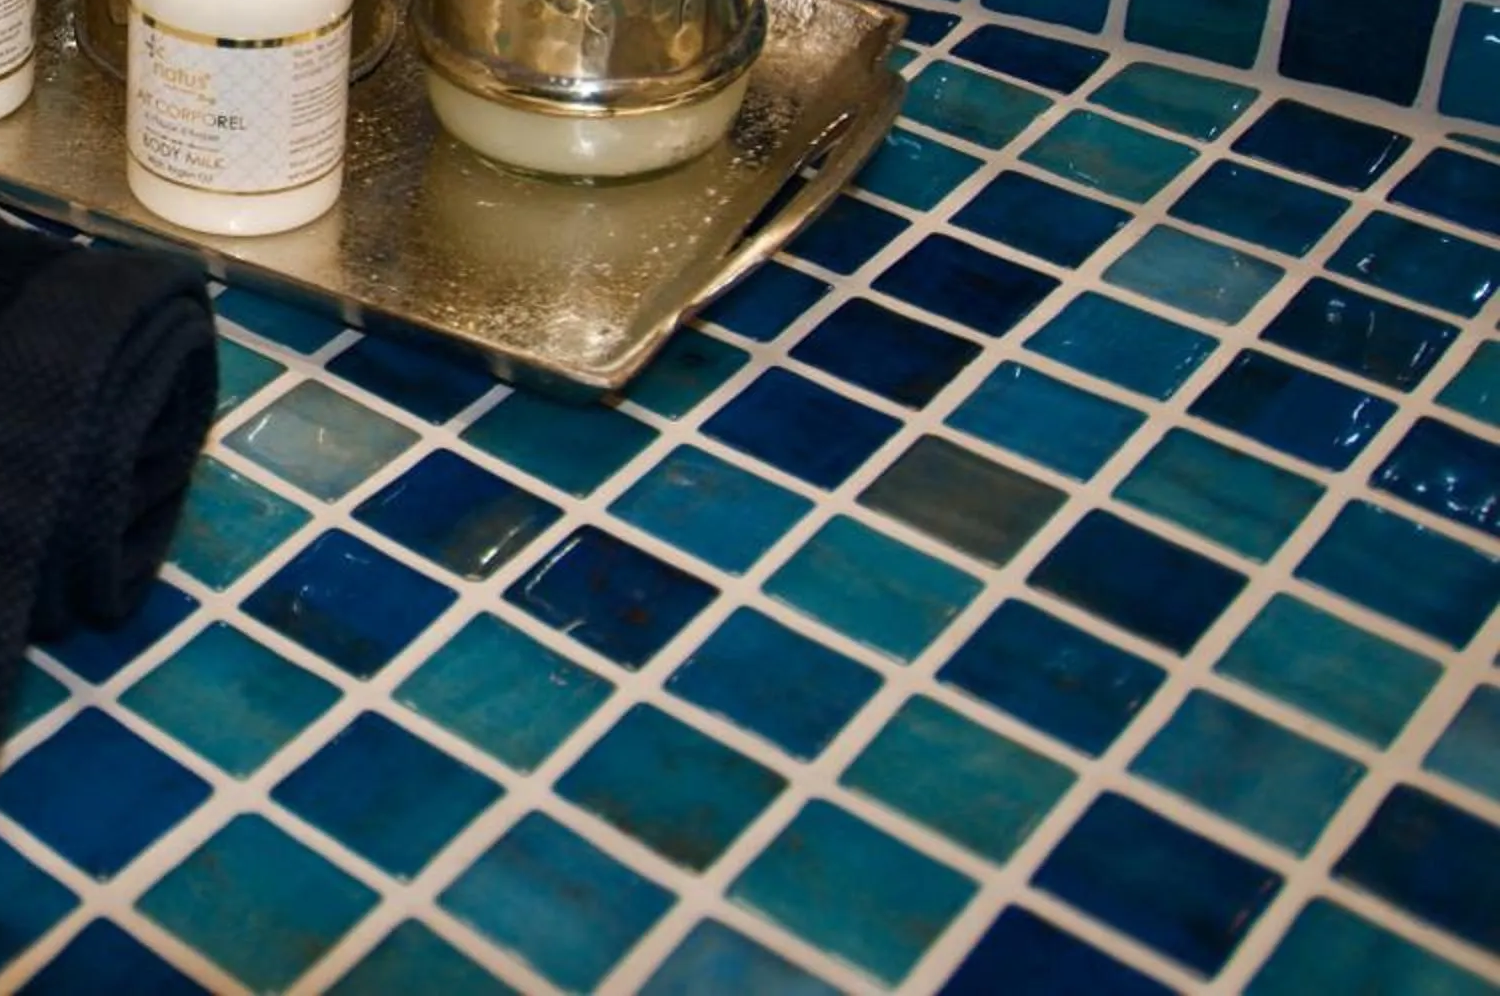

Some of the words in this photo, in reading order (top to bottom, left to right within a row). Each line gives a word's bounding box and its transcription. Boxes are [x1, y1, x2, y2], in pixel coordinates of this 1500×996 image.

[153, 60, 207, 90] natus
[156, 98, 247, 131] CORPOREL
[143, 133, 180, 161] BODY
[185, 151, 226, 170] MILK
